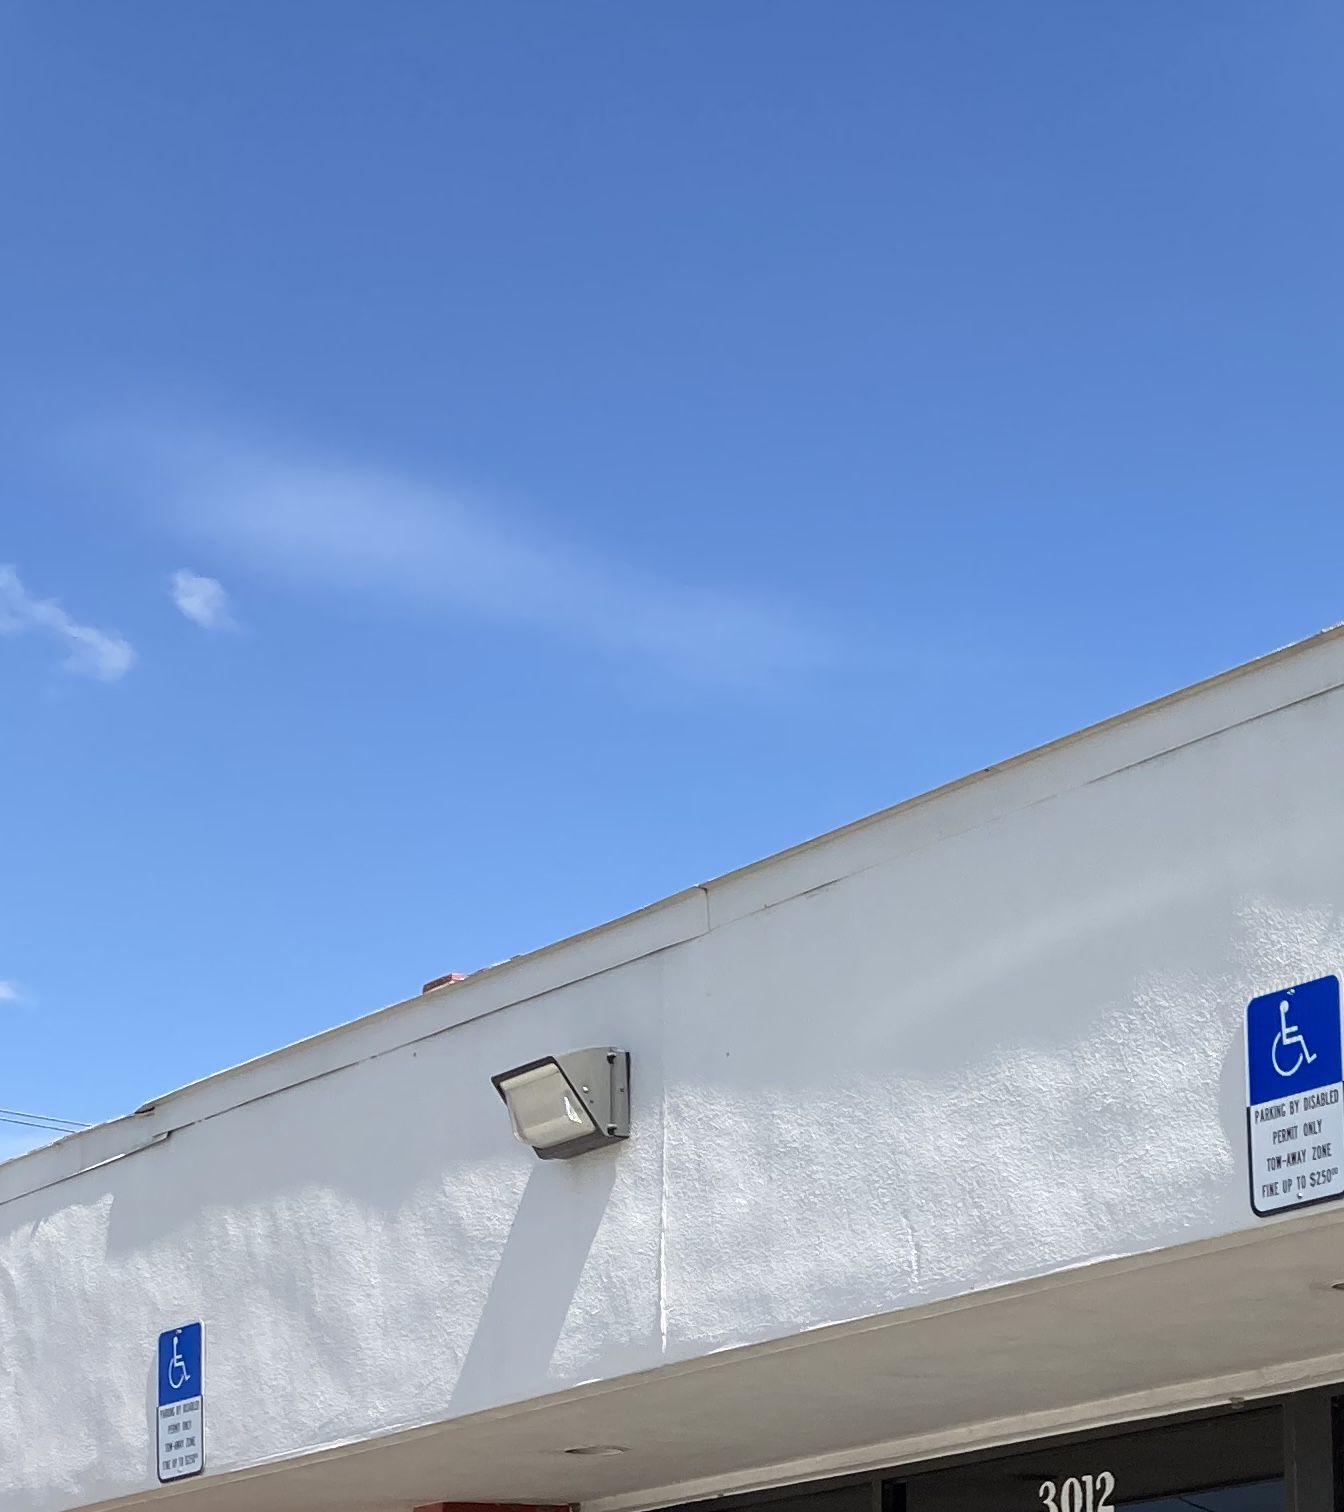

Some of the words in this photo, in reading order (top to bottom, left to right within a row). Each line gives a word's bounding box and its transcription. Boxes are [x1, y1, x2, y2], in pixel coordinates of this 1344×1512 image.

[1255, 1103, 1287, 1124] PARKING
[1289, 1101, 1300, 1115] BY
[1303, 1089, 1339, 1111] DISABLED
[1272, 1125, 1298, 1145] PERMIT
[1303, 1119, 1322, 1136] ONLY
[1267, 1149, 1307, 1172] TOW-AWAY
[1312, 1143, 1332, 1160] ZONE
[1262, 1182, 1279, 1198] FINE
[1282, 1179, 1292, 1194] UP
[1296, 1175, 1306, 1190] TO
